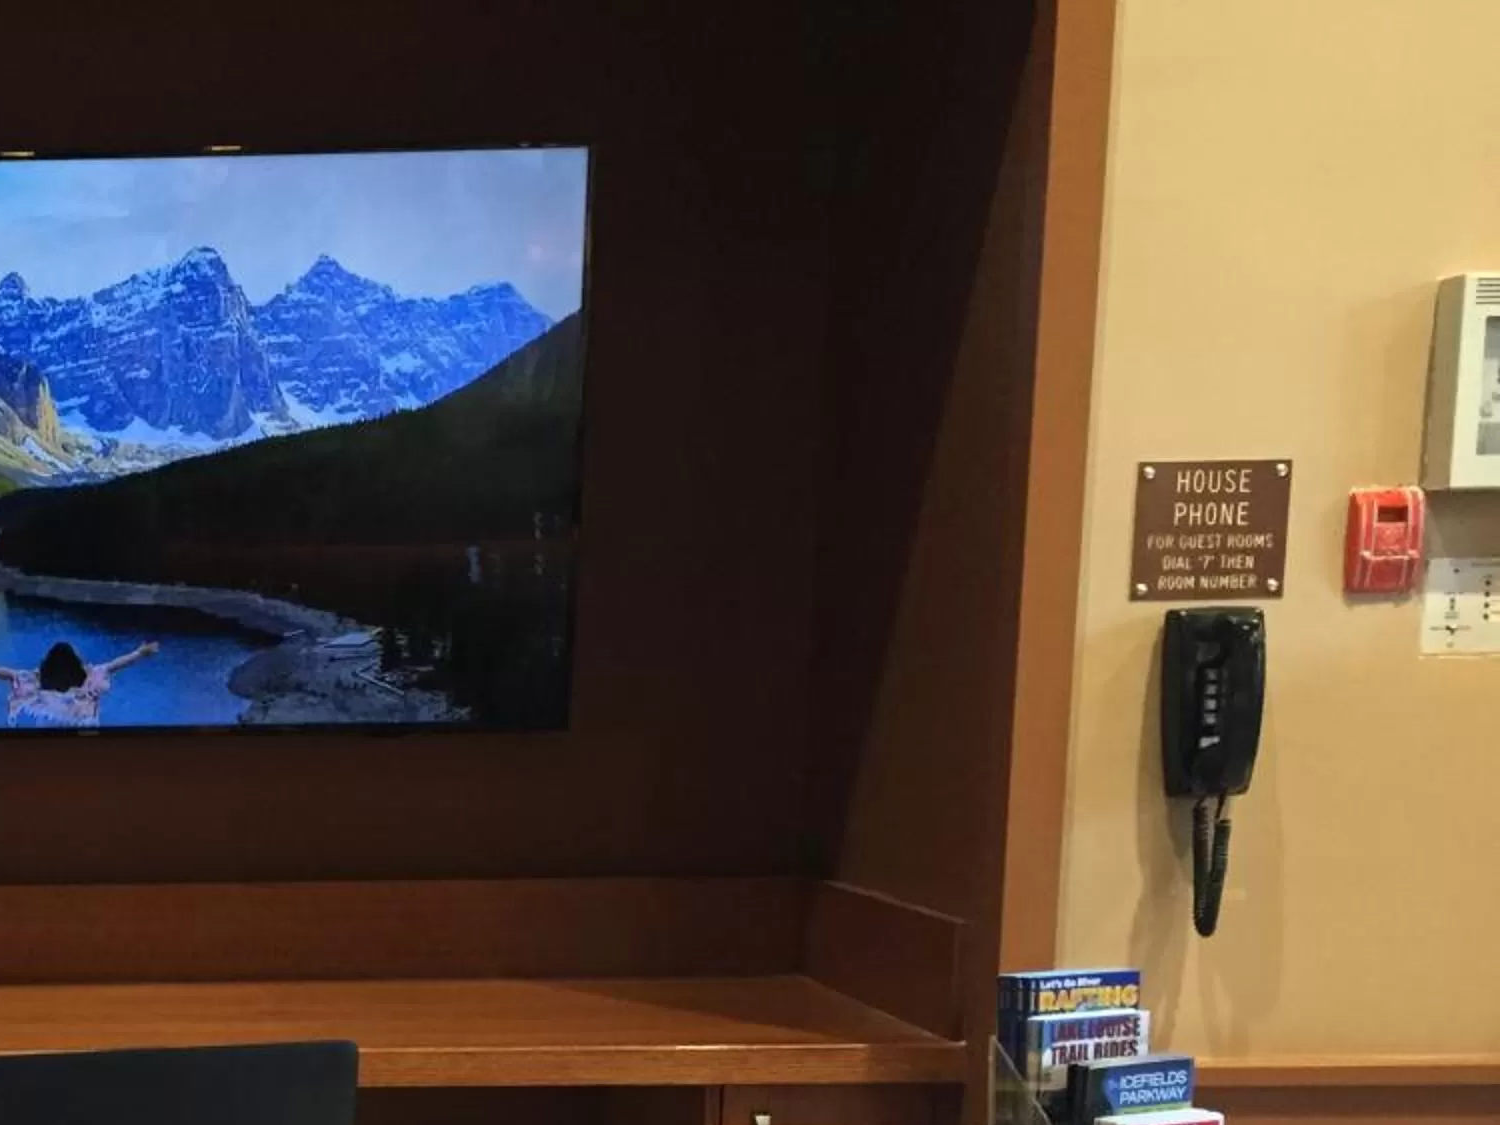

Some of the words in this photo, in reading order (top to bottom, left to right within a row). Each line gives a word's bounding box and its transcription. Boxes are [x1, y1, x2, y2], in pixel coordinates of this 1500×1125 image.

[1176, 469, 1252, 493] HOUSE
[1173, 501, 1250, 526] PHONE
[1147, 535, 1175, 549] FOR
[1179, 534, 1222, 548] GUEST
[1227, 532, 1274, 548] ROOMS
[1161, 555, 1191, 571] DIAL
[1220, 554, 1255, 569] THEN
[1157, 575, 1195, 590] ROOM
[1199, 574, 1257, 589] NUMBER
[1051, 1043, 1089, 1066] TRAIL
[1093, 1039, 1139, 1060] RIDES
[1119, 1070, 1188, 1089] ICEFIELDS
[1119, 1085, 1186, 1105] PARKWAY
